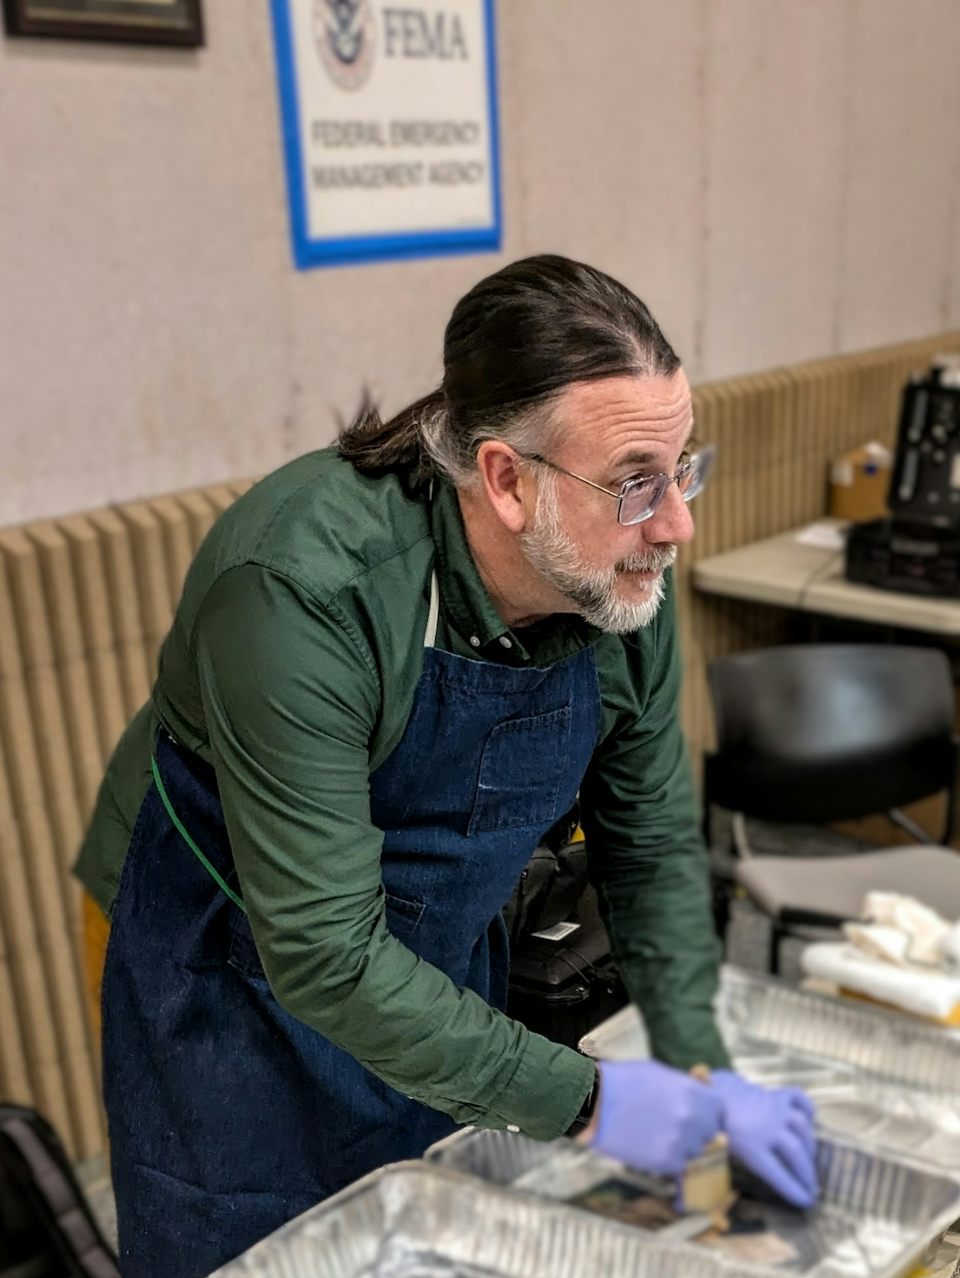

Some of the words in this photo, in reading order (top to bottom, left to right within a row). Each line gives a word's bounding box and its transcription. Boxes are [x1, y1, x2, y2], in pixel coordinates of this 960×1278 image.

[382, 7, 468, 60] FEMA
[311, 119, 385, 148] FEDERAL
[389, 120, 480, 147] EMERGENCY
[311, 161, 423, 190] MANAGEMENT
[429, 160, 484, 186] AGENCY
